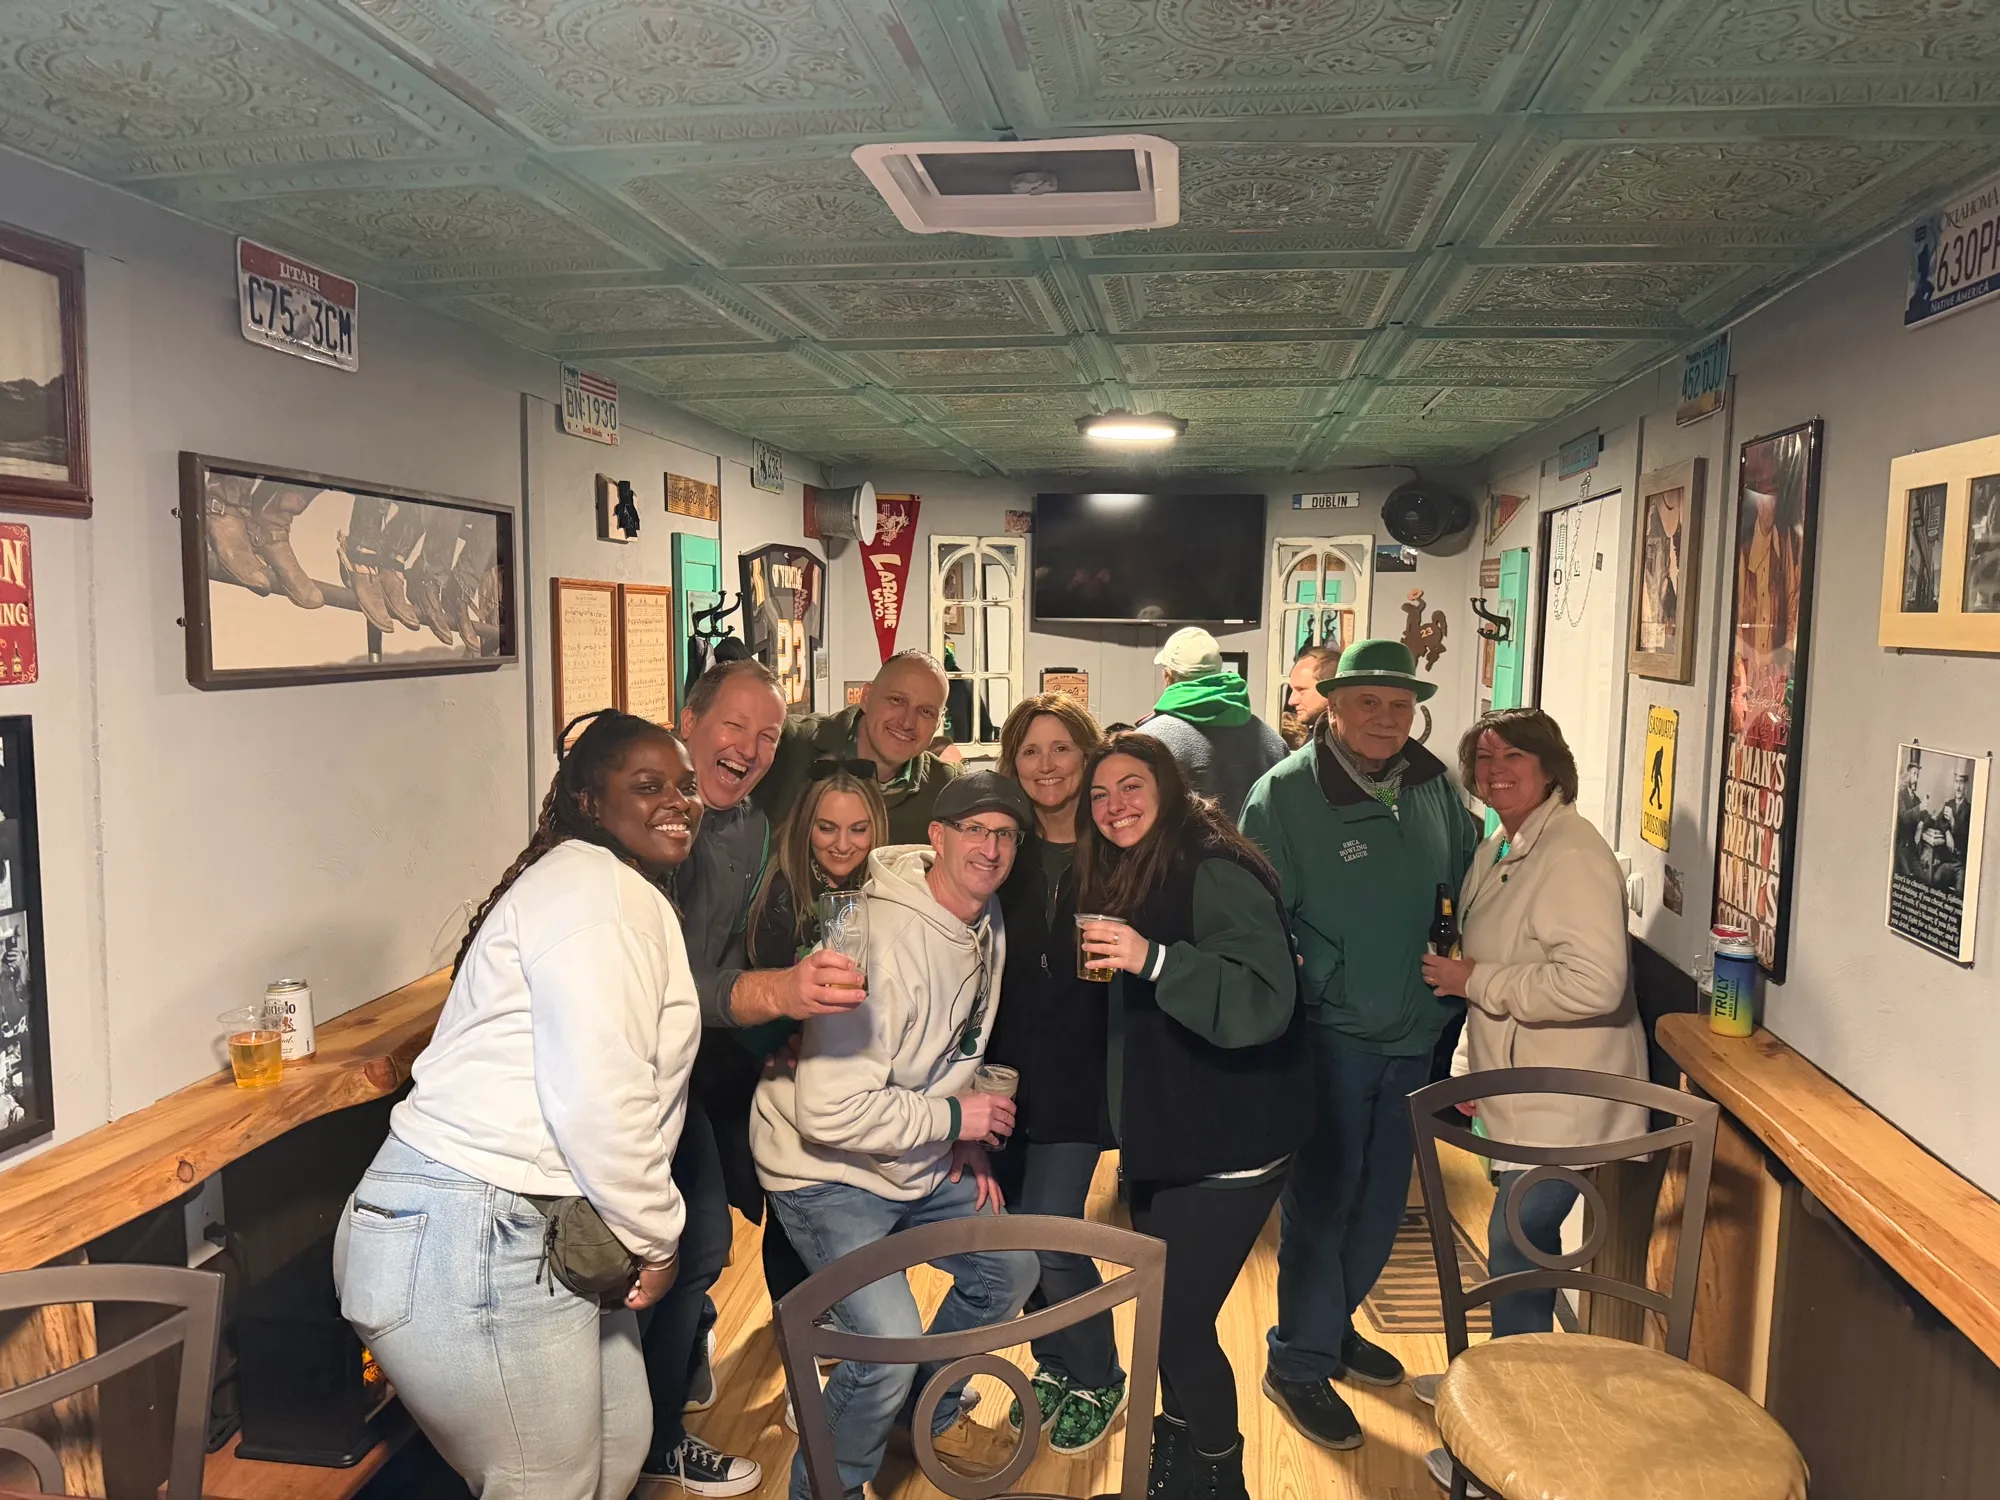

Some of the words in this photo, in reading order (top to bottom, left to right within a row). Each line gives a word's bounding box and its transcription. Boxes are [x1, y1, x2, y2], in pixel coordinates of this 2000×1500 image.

[279, 262, 320, 291] UTAH
[248, 276, 294, 336] C75
[310, 299, 352, 355] 3CM
[1312, 495, 1348, 508] DUBLIN
[869, 553, 902, 629] LARAMIE
[871, 587, 885, 620] WYO.
[1420, 626, 1434, 638] 23
[1727, 742, 1736, 776] A
[1741, 746, 1787, 793] MAN'S
[1725, 778, 1760, 822] GOTTA
[1765, 792, 1784, 831] DO
[1643, 811, 1668, 840] CROSSING
[1723, 814, 1765, 862] WHAT
[1771, 833, 1781, 873] A
[1340, 843, 1368, 857] BOWLING
[1343, 850, 1368, 862] LEAGUE
[1719, 851, 1780, 930] MAN'S
[1715, 974, 1729, 1017] TRULY
